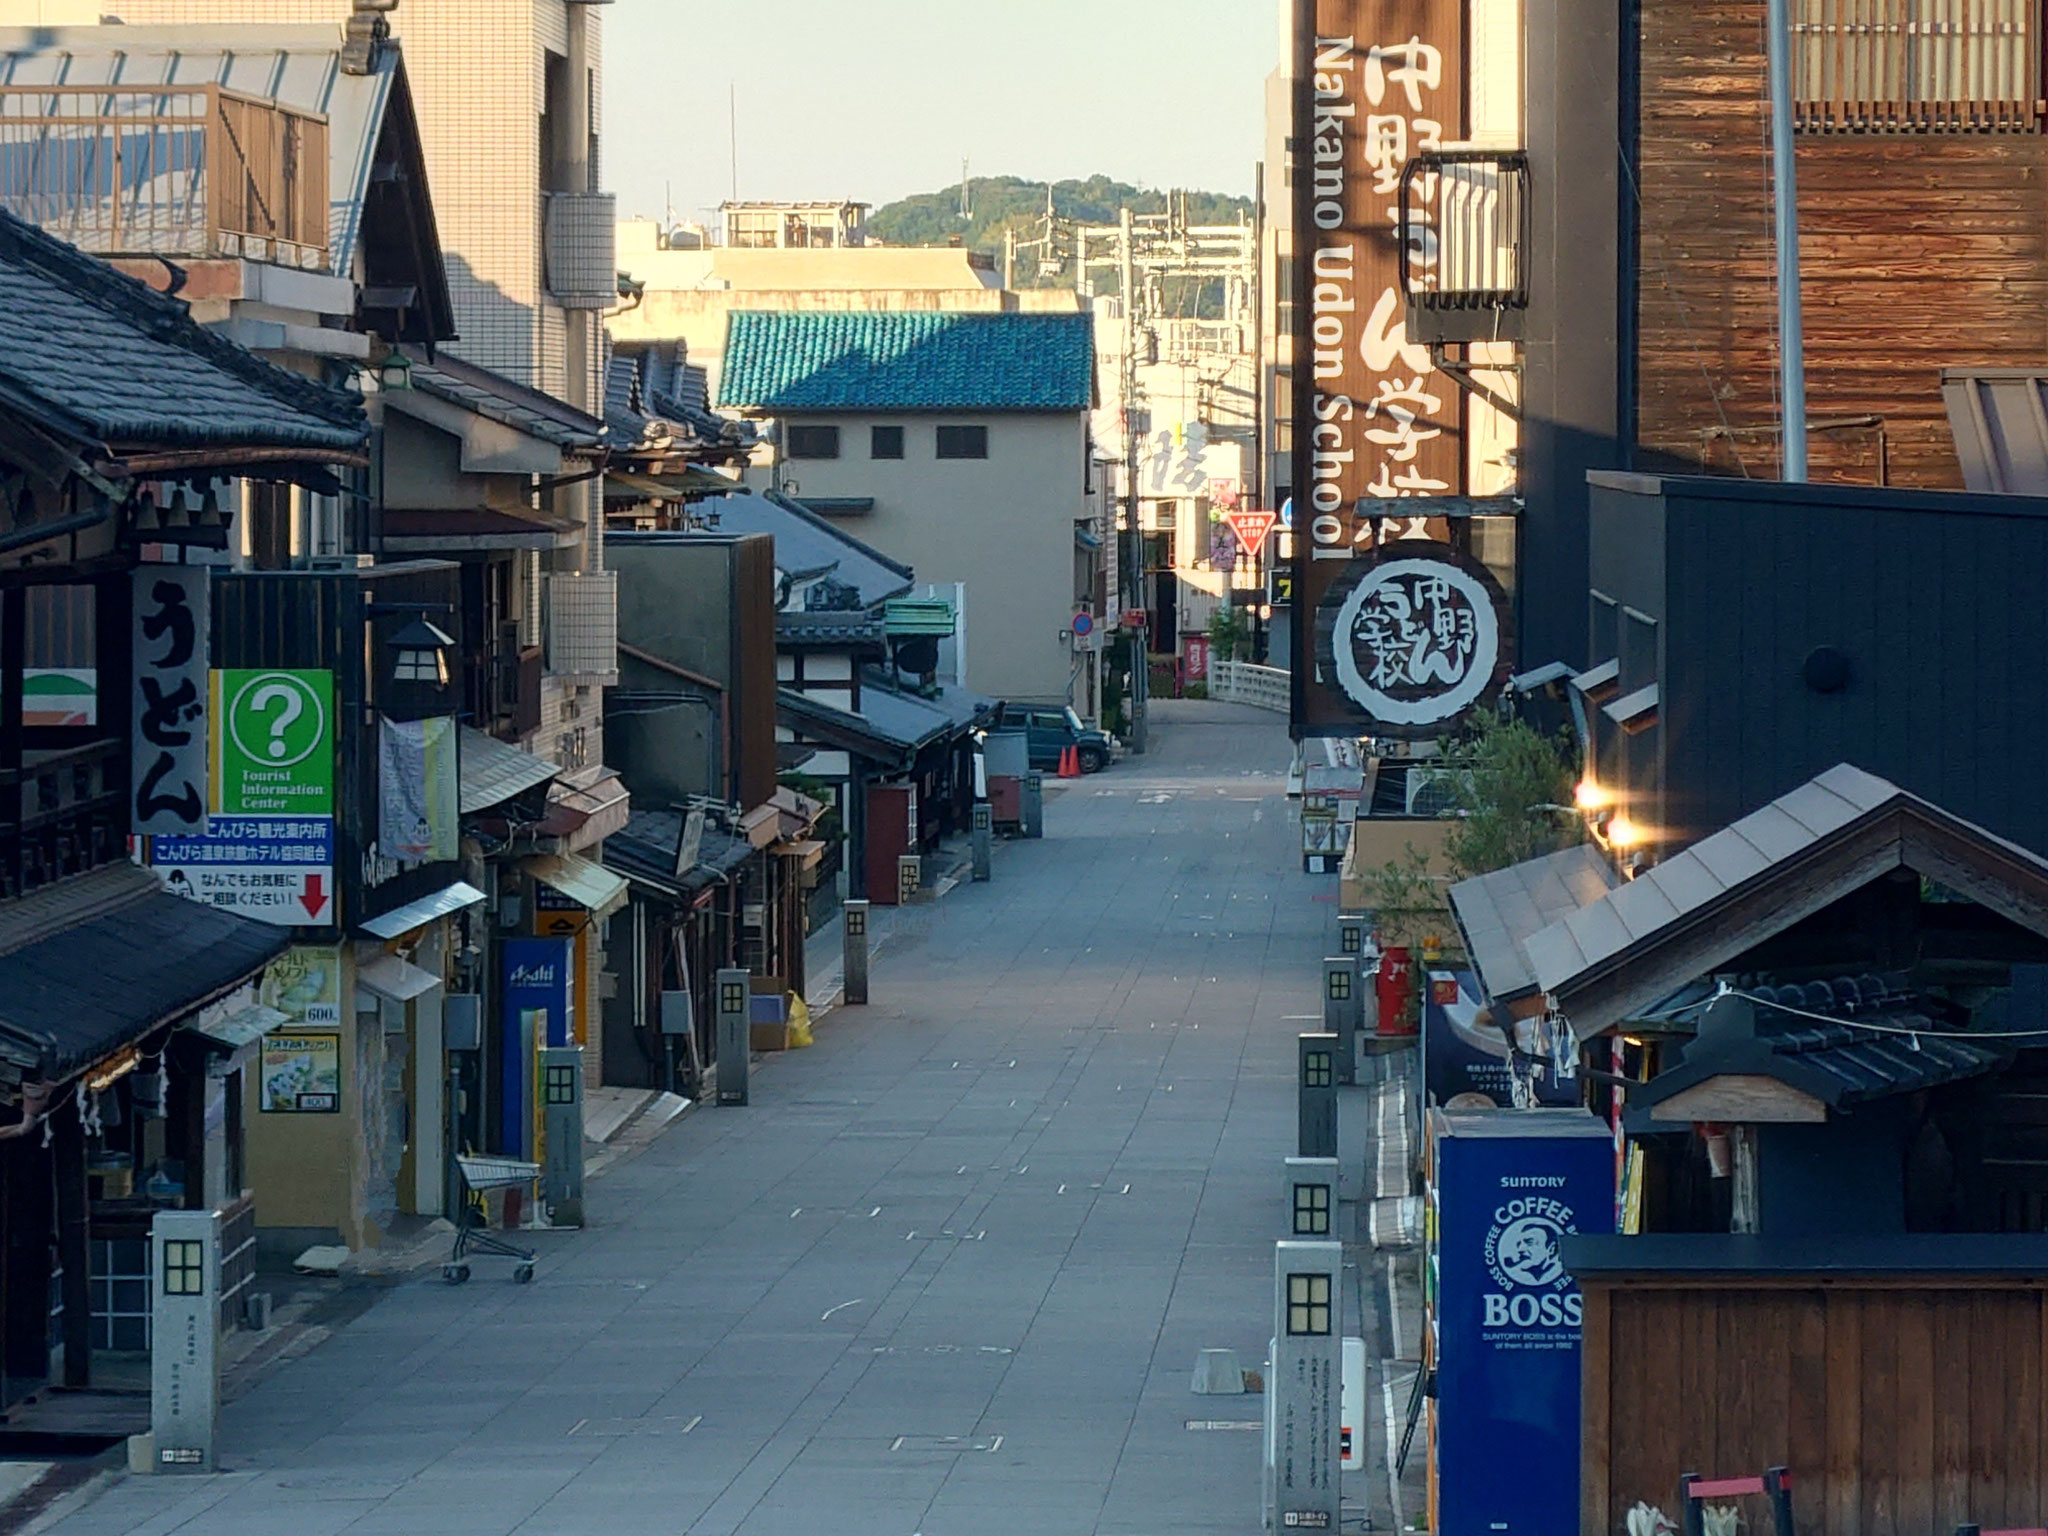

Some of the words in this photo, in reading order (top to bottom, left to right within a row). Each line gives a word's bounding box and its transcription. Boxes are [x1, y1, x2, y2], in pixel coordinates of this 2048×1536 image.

[1314, 35, 1355, 229] Nakano
[1313, 244, 1355, 380] Udon
[1312, 394, 1354, 561] School
[1238, 517, 1265, 527] 止まれ
[1242, 528, 1262, 537] STOP
[137, 580, 203, 824] うどん
[242, 770, 291, 781] Tourist
[242, 783, 324, 795] Information
[242, 797, 288, 809] Center
[201, 873, 297, 887] なんでもお気軽に
[510, 964, 554, 981] Asahi
[308, 1007, 333, 1021] 600
[1500, 1176, 1567, 1188] SUNTORY
[1494, 1197, 1574, 1226] COFFEE
[1484, 1224, 1502, 1266] COFFEE
[1489, 1266, 1514, 1292] BOSS
[1482, 1294, 1582, 1327] BOSS
[1482, 1332, 1522, 1340] SUNTORY
[1523, 1332, 1546, 1340] BOSS
